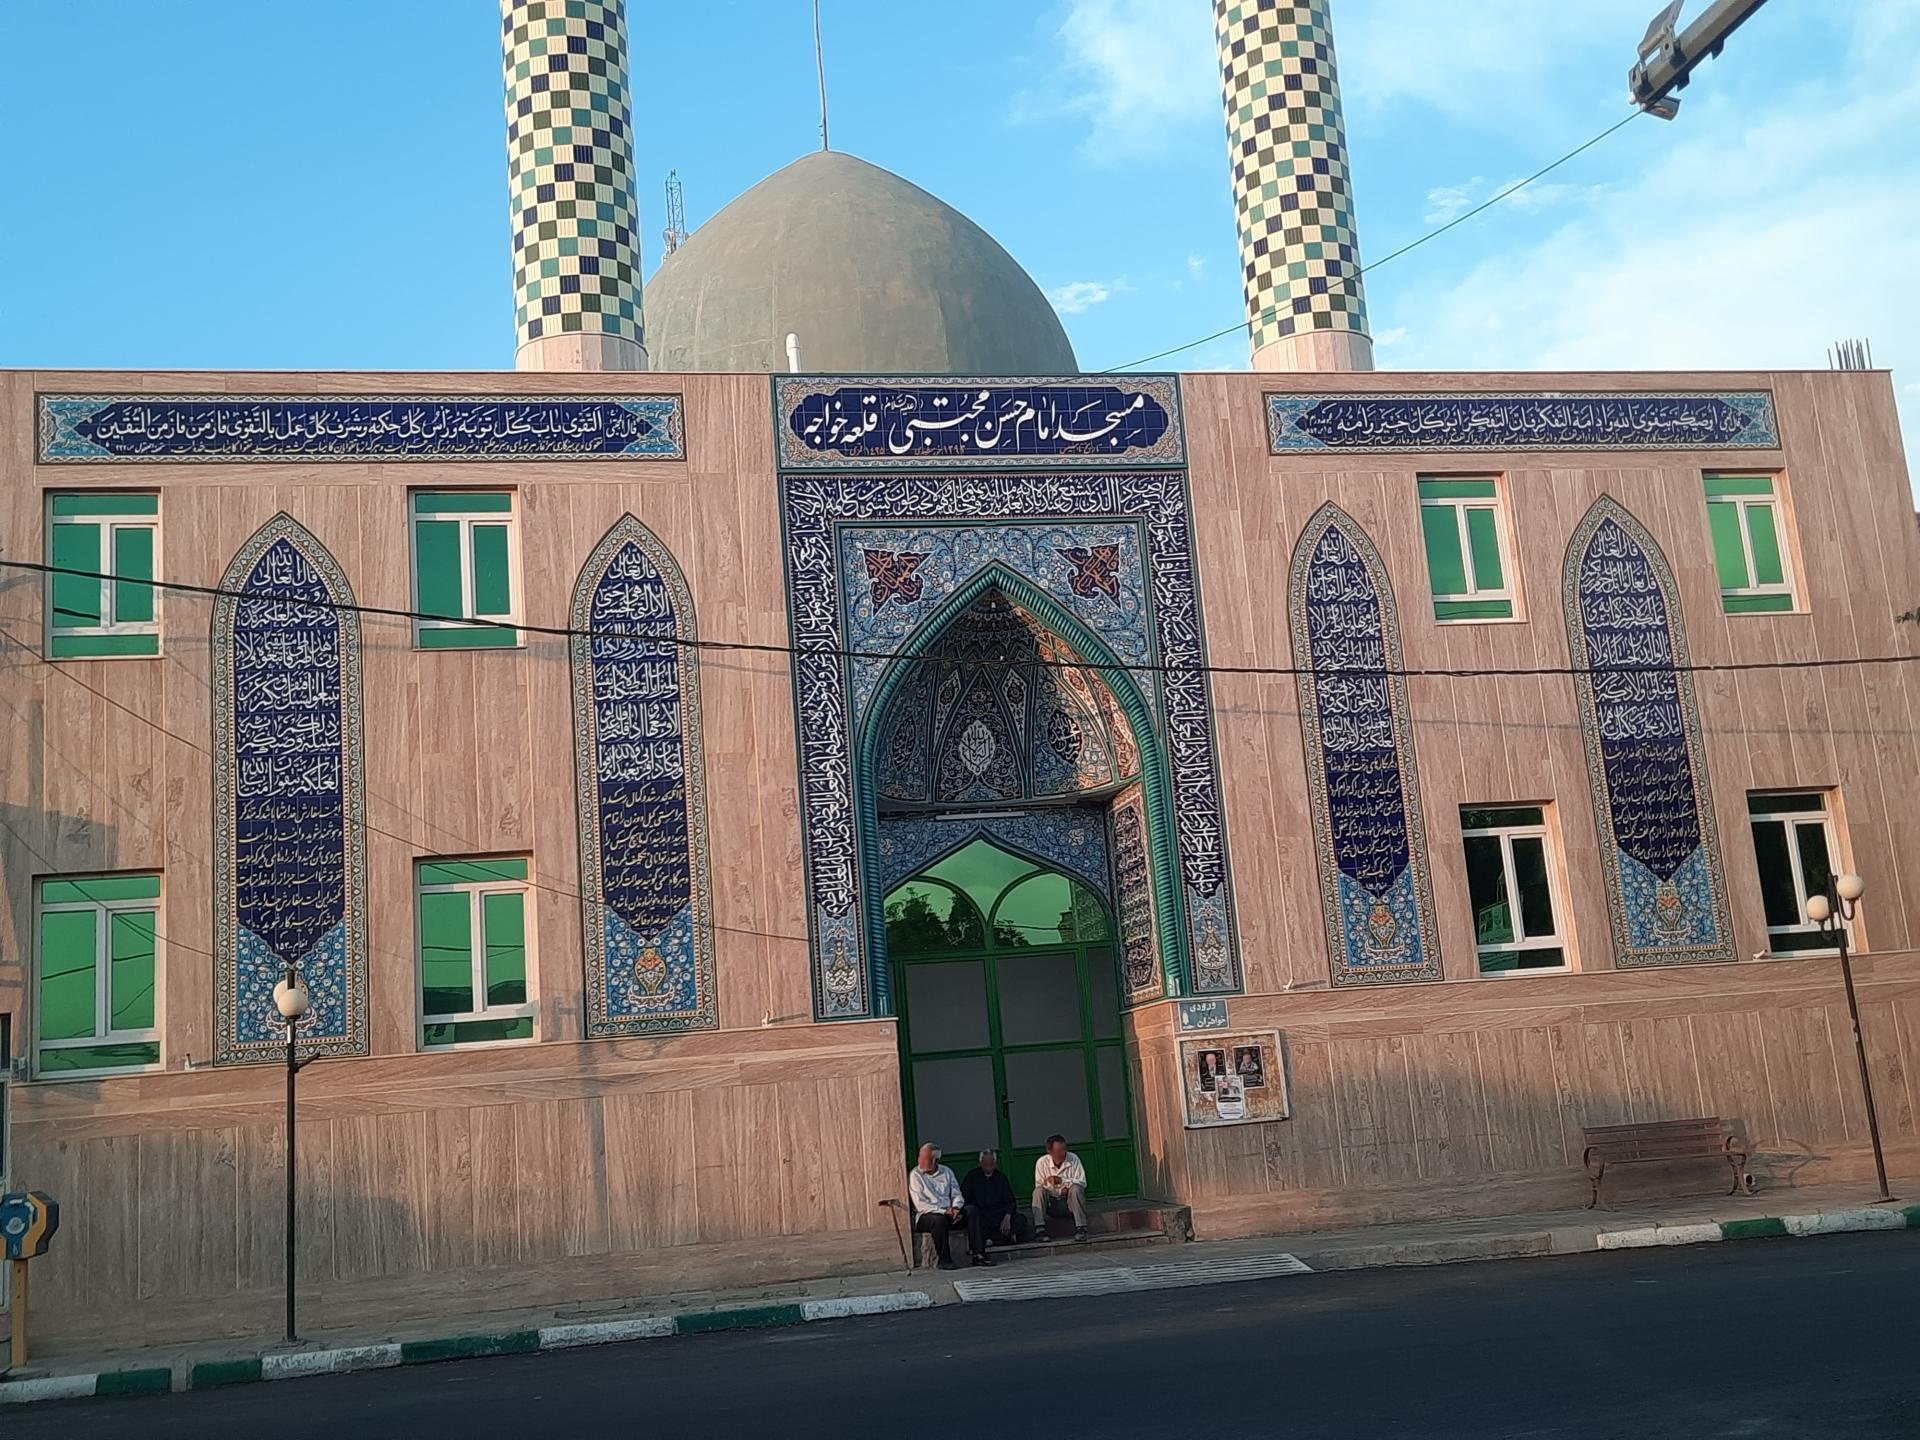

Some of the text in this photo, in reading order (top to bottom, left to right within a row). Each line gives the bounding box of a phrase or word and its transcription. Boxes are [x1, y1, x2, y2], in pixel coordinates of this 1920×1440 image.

[804, 401, 848, 444] خواجه
[841, 395, 878, 444] قلعه
[889, 390, 990, 455] مجتبی
[975, 398, 1028, 449] حسن
[1017, 396, 1056, 453] امام
[1053, 395, 1144, 447] مسجد
[1190, 1002, 1216, 1012] ورودی
[1197, 1015, 1226, 1028] خواهران
